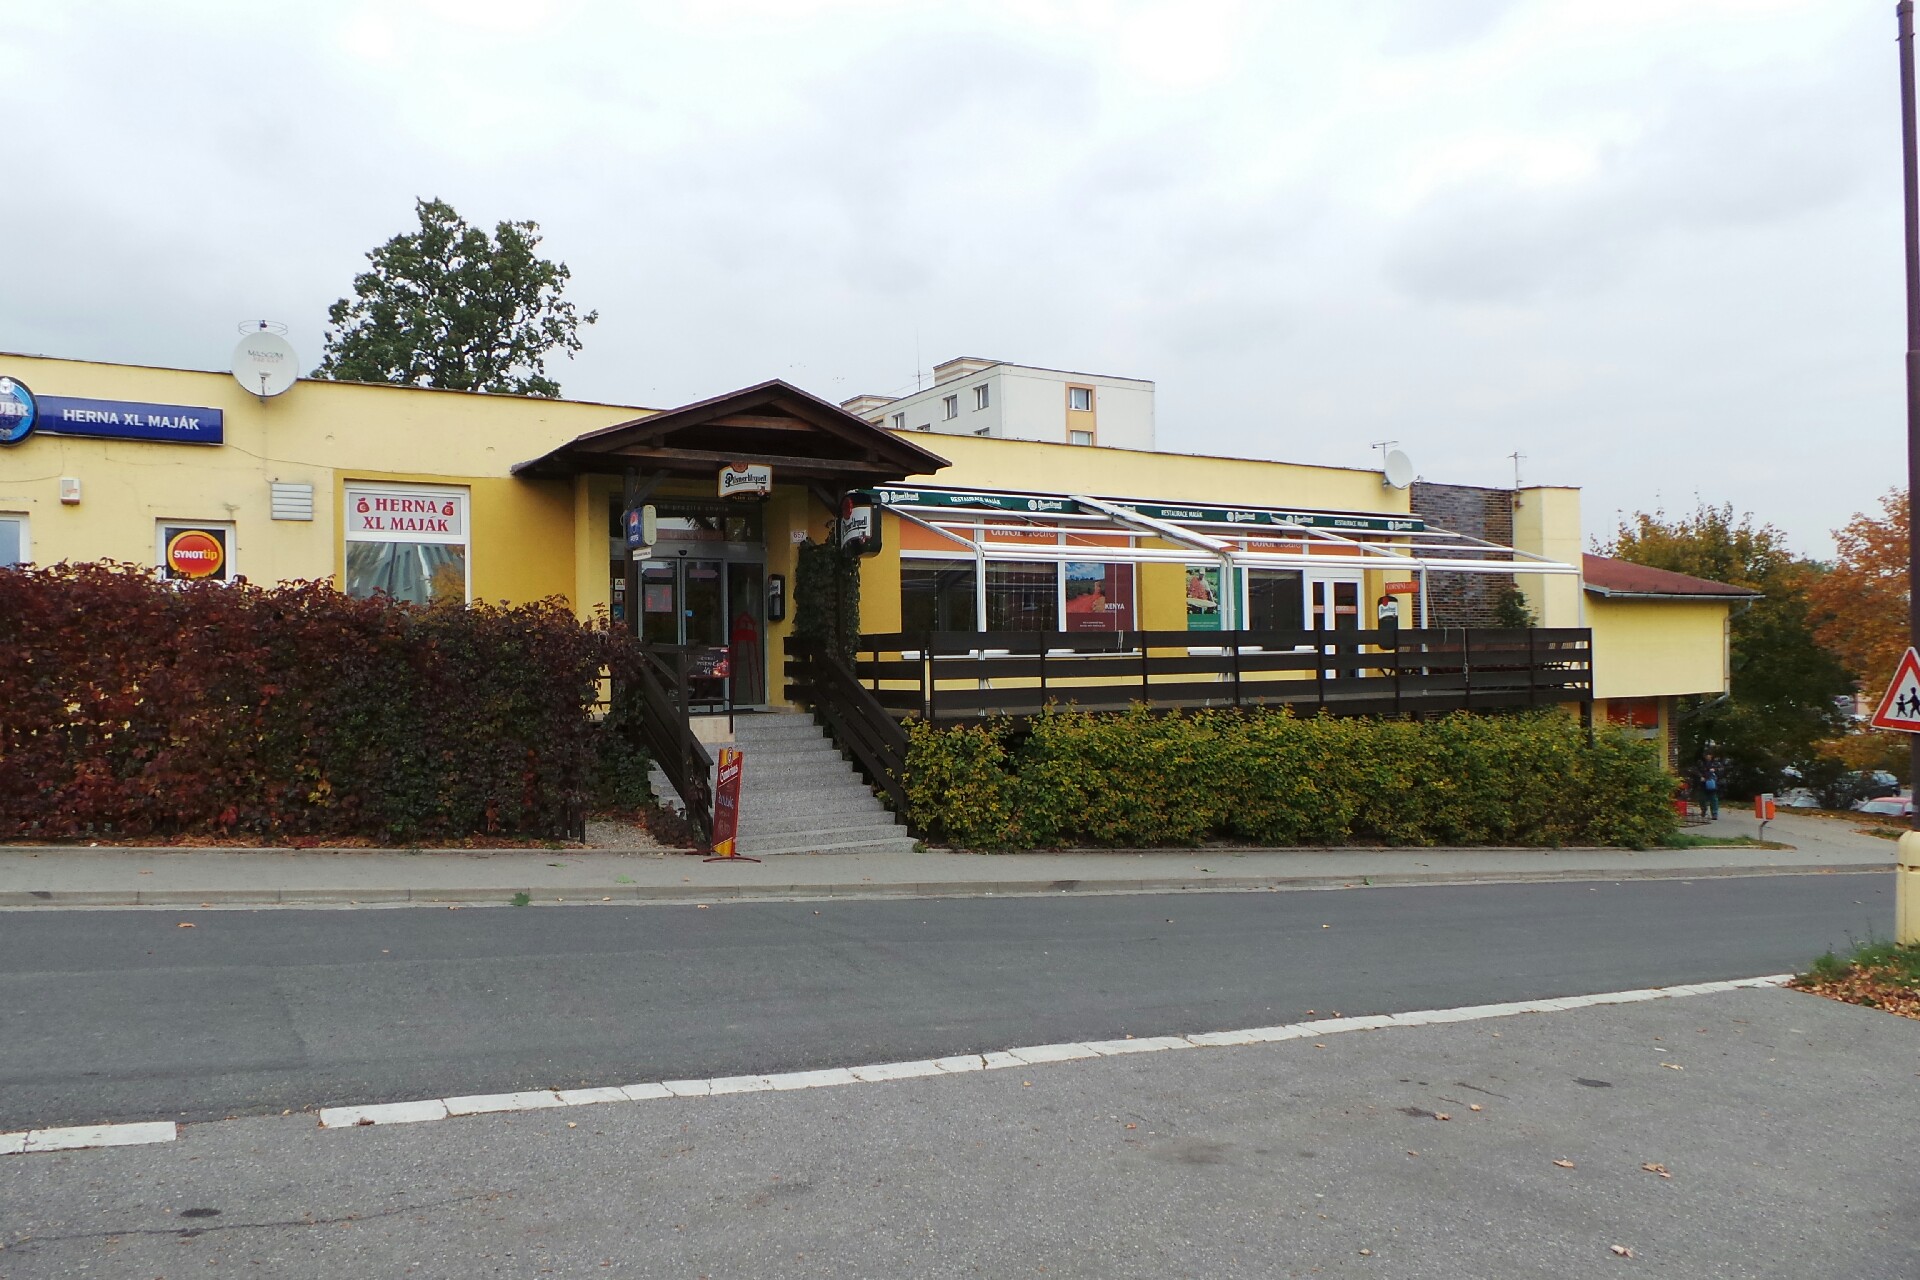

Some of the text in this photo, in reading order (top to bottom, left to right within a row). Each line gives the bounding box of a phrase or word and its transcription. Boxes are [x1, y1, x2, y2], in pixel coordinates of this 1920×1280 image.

[63, 409, 200, 431] HERNA XL MAJÁK
[375, 498, 438, 513] HERNA
[363, 516, 449, 532] XL MAJÁK
[1104, 602, 1125, 610] KENYA
